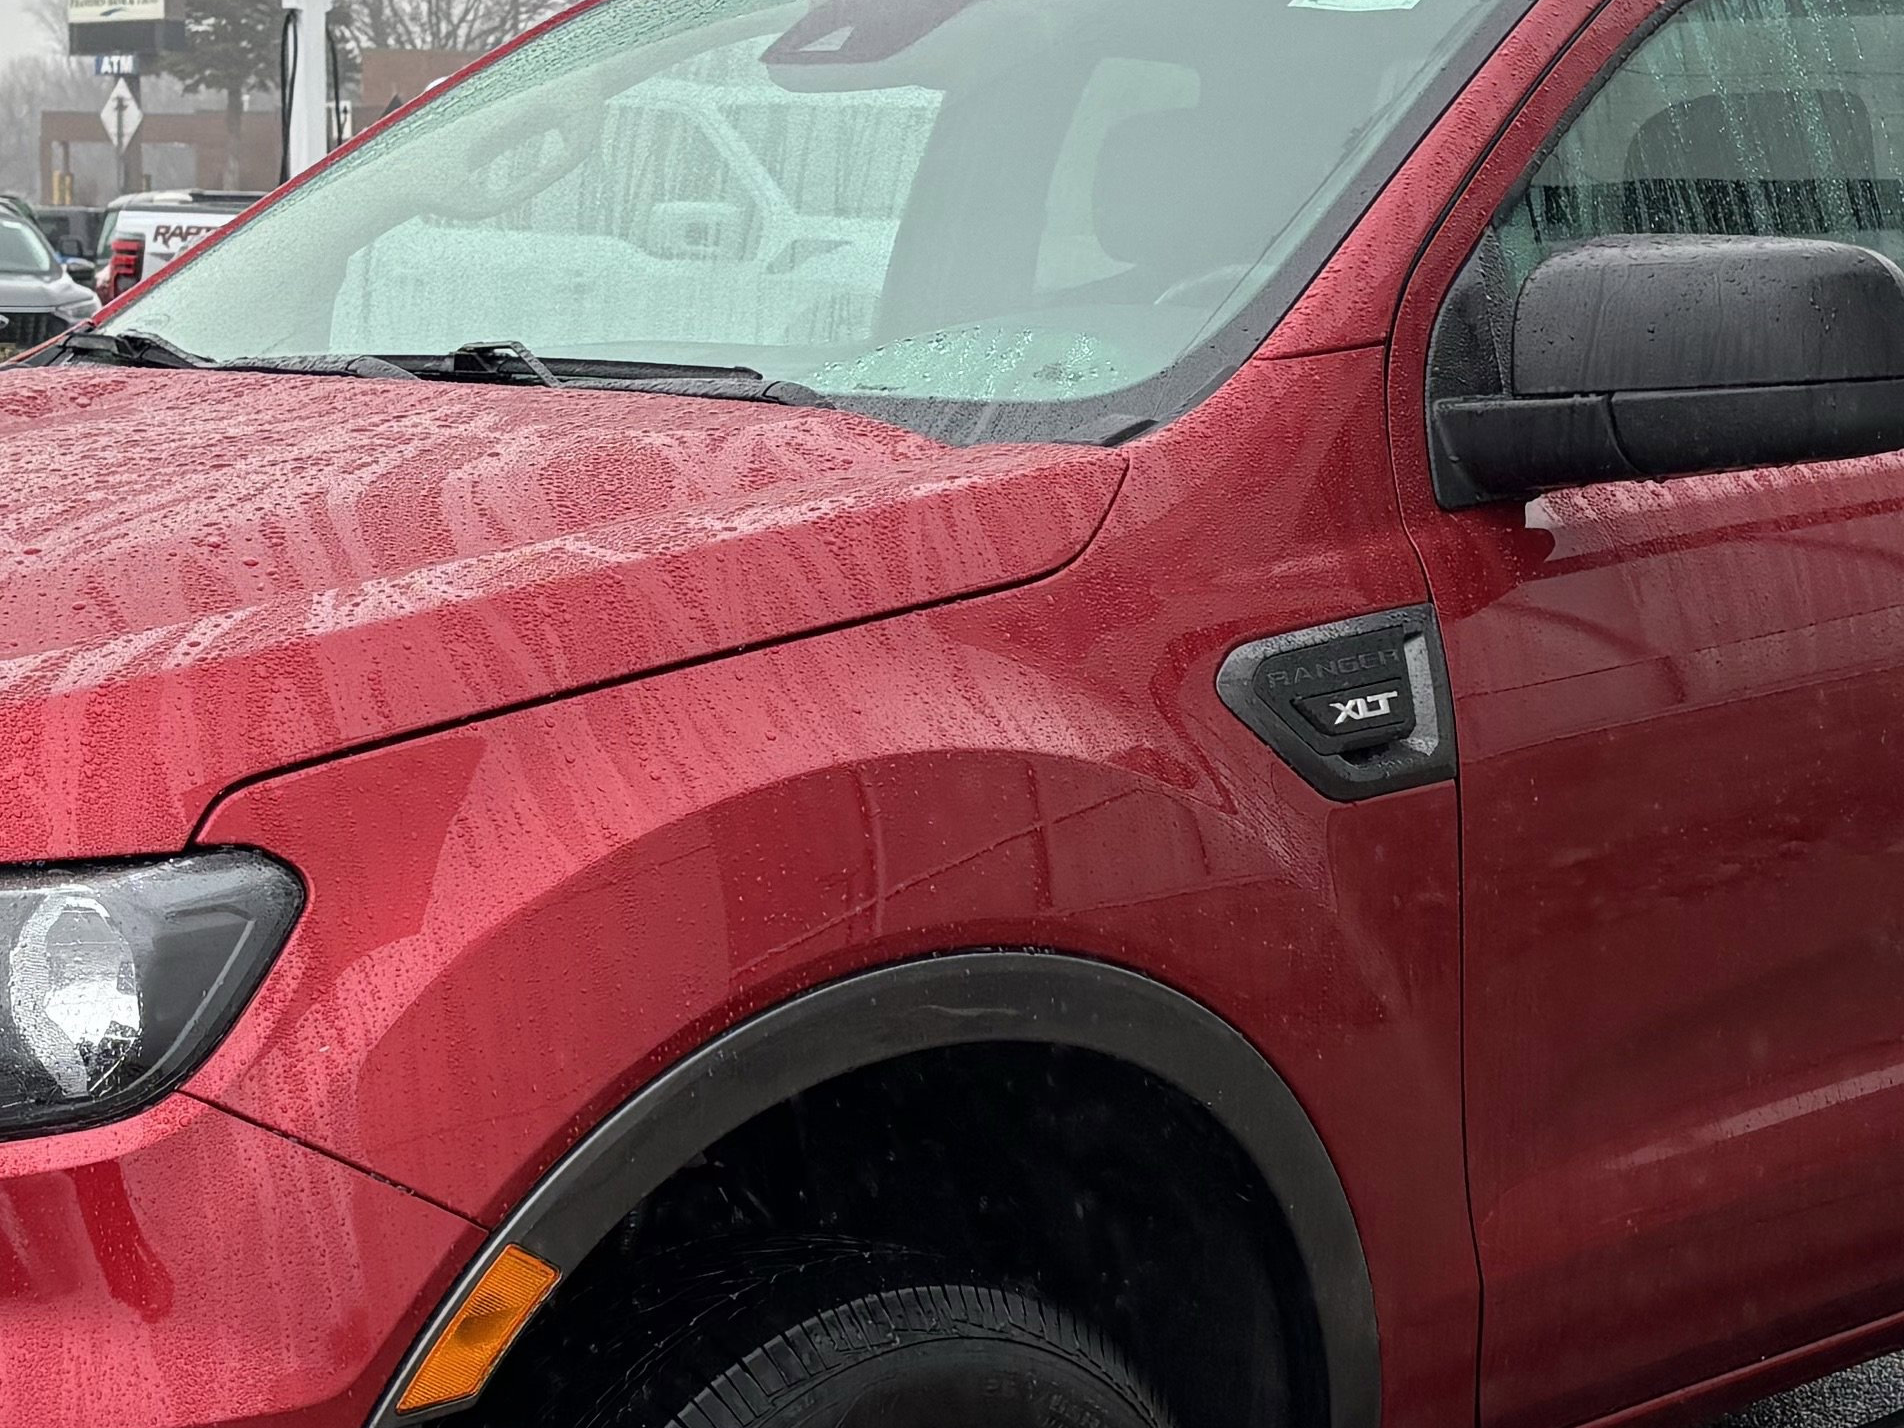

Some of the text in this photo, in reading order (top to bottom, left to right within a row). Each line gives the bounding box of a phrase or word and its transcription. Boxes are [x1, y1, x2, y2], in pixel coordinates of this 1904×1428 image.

[100, 55, 133, 74] ATM
[1266, 649, 1400, 689] RANGER
[1329, 690, 1399, 725] XLT
